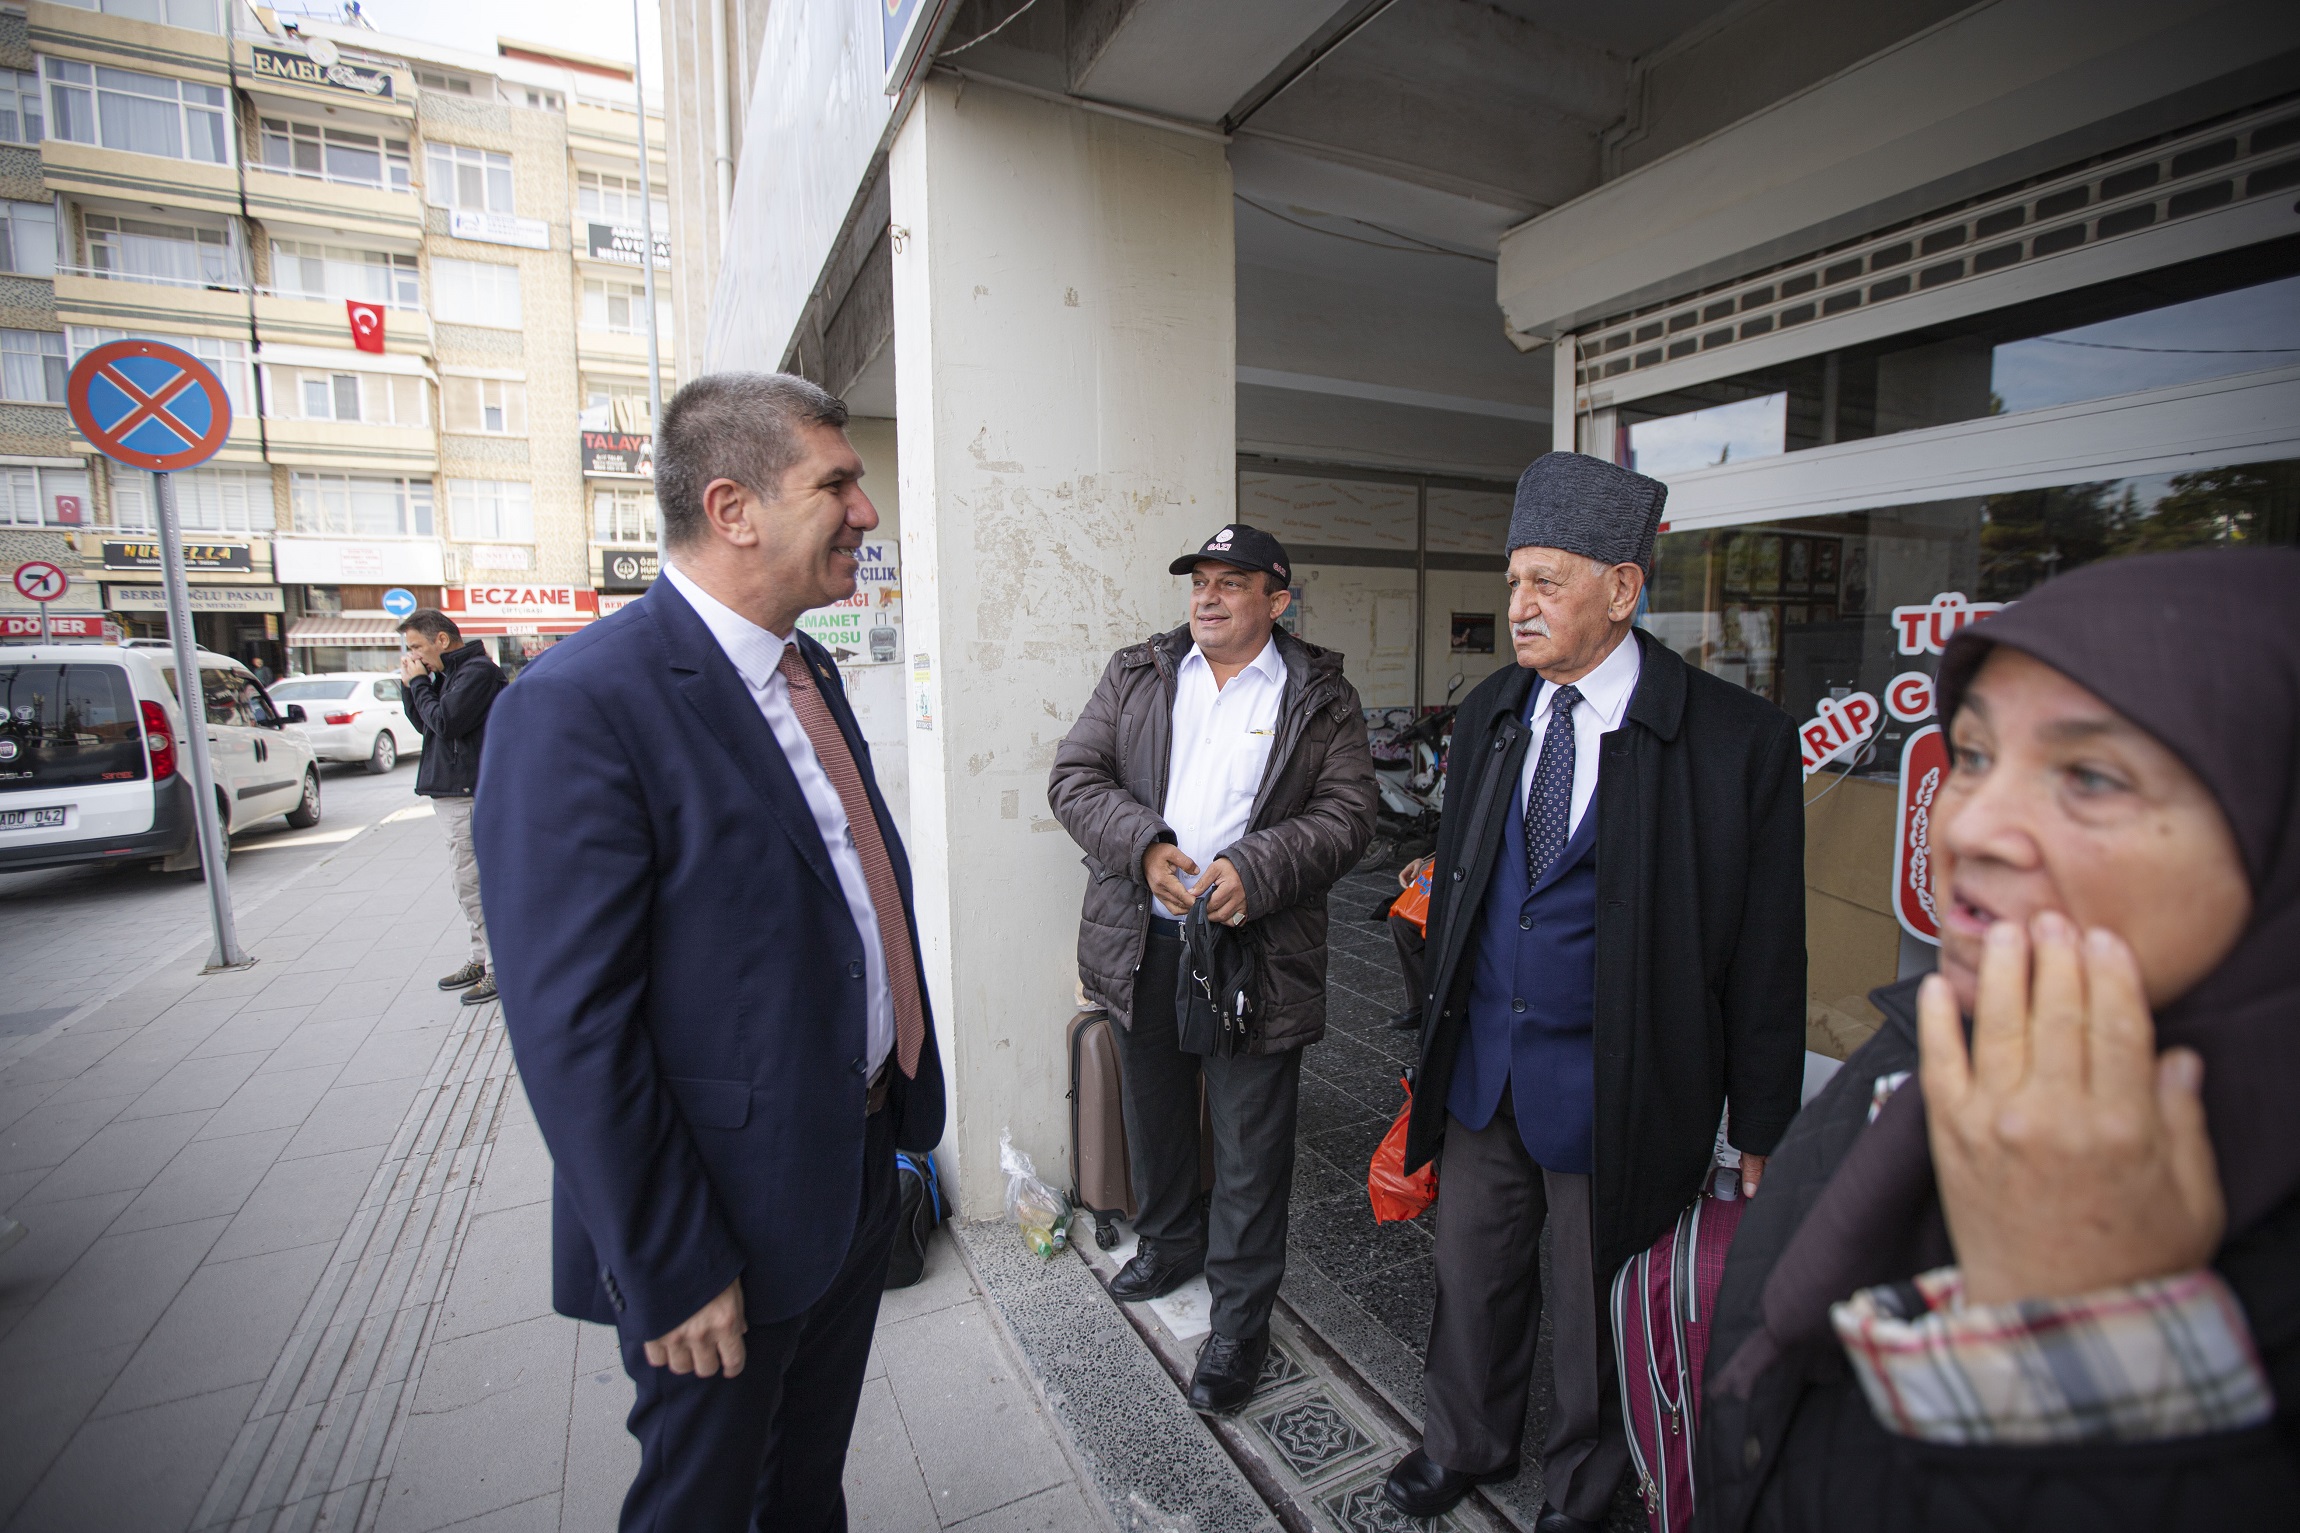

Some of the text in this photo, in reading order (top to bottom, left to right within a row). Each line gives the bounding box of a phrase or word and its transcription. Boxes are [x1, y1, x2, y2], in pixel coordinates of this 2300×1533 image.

[255, 53, 330, 85] EMEL
[583, 433, 641, 452] TALAY
[854, 545, 882, 562] AN
[854, 566, 897, 585] ÇILIK
[471, 588, 570, 605] ECZANE
[795, 614, 861, 628] EMANET
[808, 631, 861, 644] EPOSU
[35, 810, 62, 823] 042
